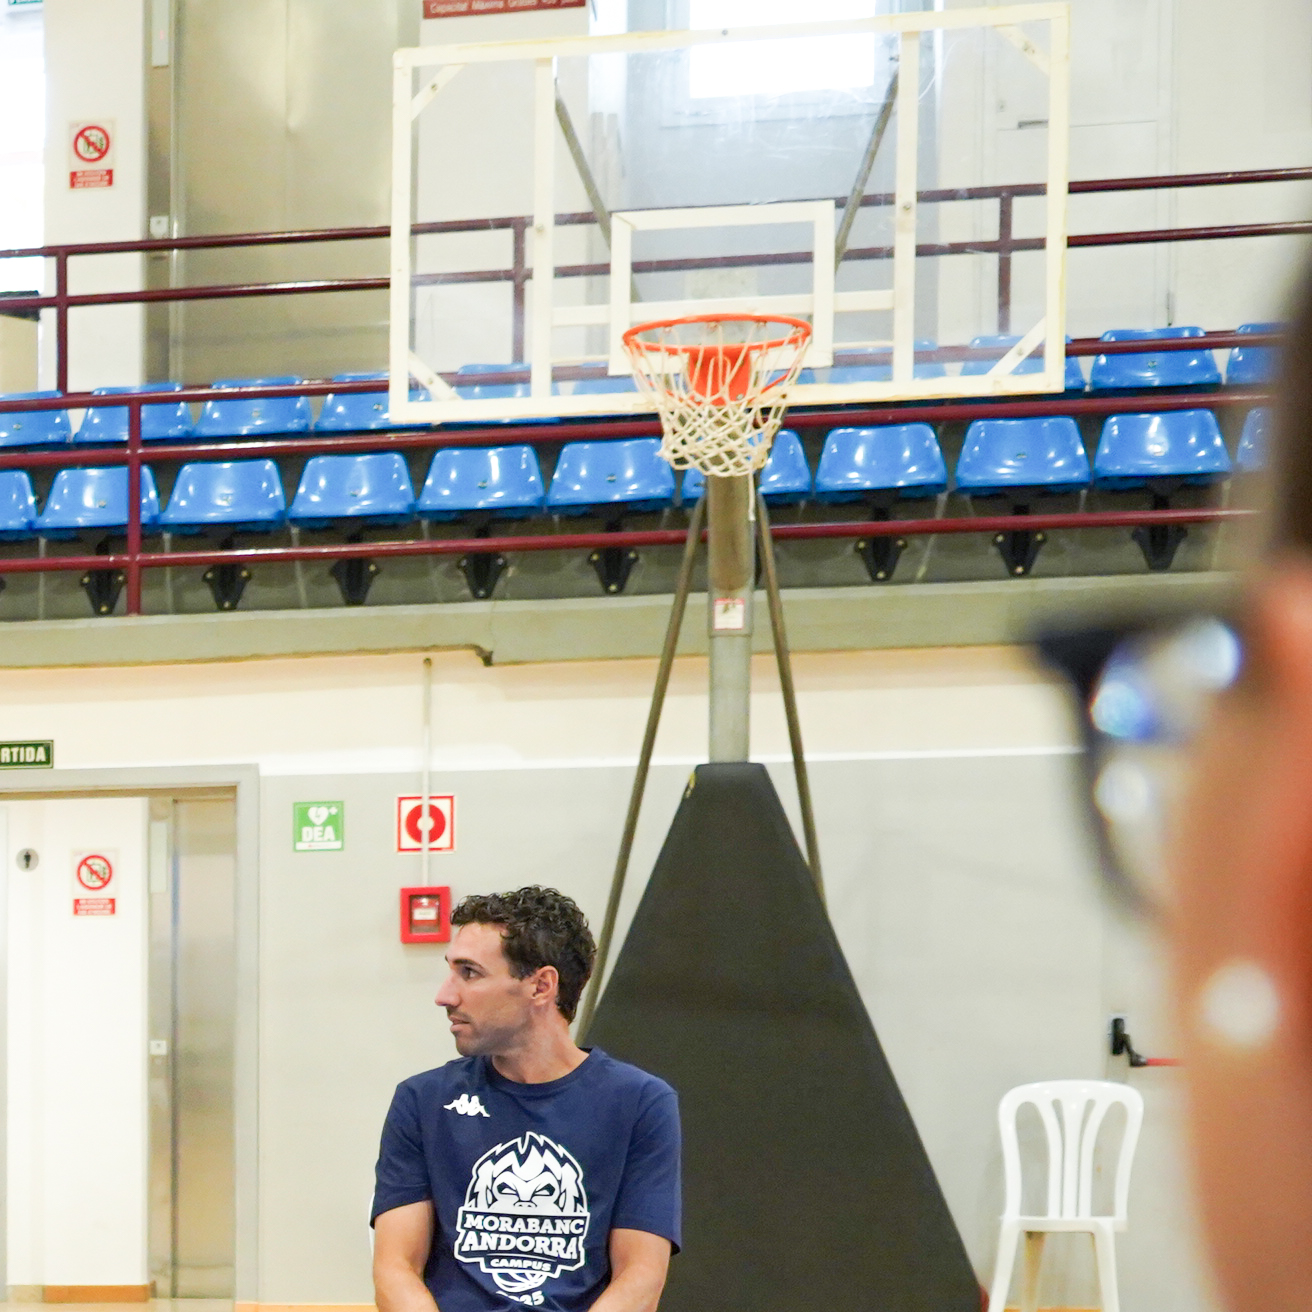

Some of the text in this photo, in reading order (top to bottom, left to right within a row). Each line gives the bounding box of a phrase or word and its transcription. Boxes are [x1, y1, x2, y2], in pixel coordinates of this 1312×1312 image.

[302, 825, 335, 842] DEA
[463, 1213, 585, 1235] MORABANC
[461, 1231, 578, 1260] ANDORRA
[490, 1258, 552, 1272] CAMPUS
[496, 1290, 545, 1306] 25
